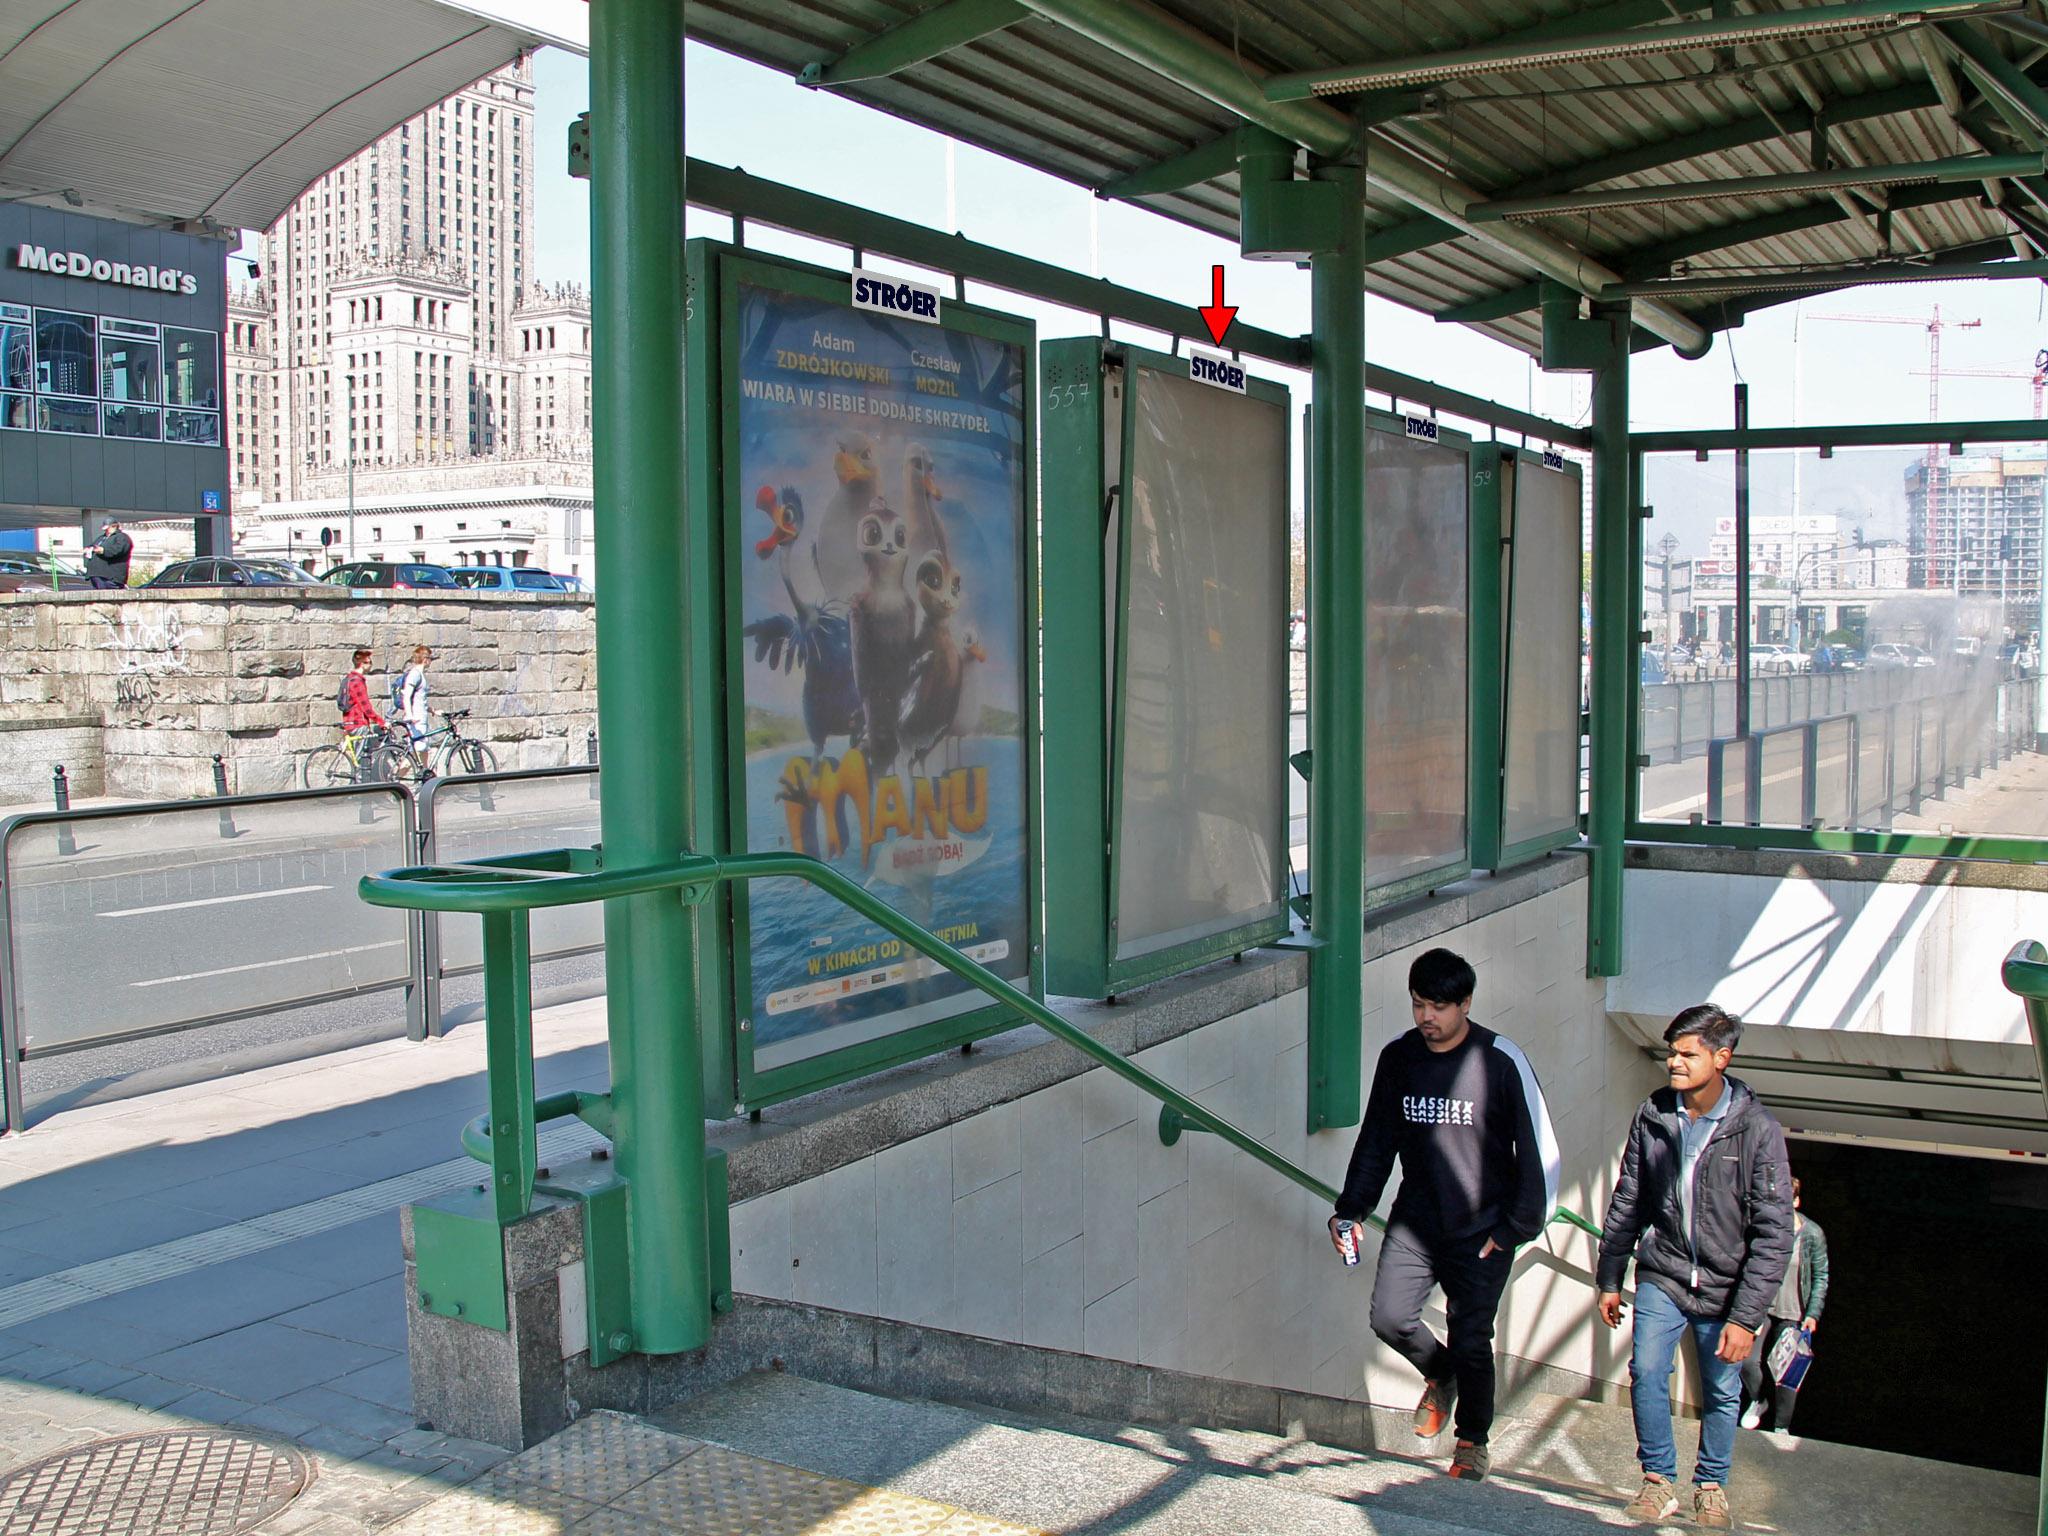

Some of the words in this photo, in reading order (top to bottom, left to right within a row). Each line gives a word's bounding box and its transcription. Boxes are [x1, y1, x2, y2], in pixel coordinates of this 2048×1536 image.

[17, 243, 198, 295] McDonald's
[812, 330, 855, 353] Adam
[777, 350, 889, 385] ZDRÓJKOWSKI
[911, 350, 961, 375] Czesław
[915, 375, 959, 398] MOZIL
[1048, 383, 1091, 410] 557
[742, 379, 796, 405] WIARA
[799, 389, 814, 408] W
[818, 391, 866, 415] SIEBIE
[870, 400, 922, 425] DODAJE
[925, 408, 990, 433] SKRZYDEŁ
[784, 748, 988, 871] MANU
[927, 842, 963, 864] OBĄ!
[808, 957, 820, 976] W
[826, 944, 876, 971] KINACH
[881, 940, 899, 958] OD
[1403, 1096, 1474, 1114] CLASSIXX
